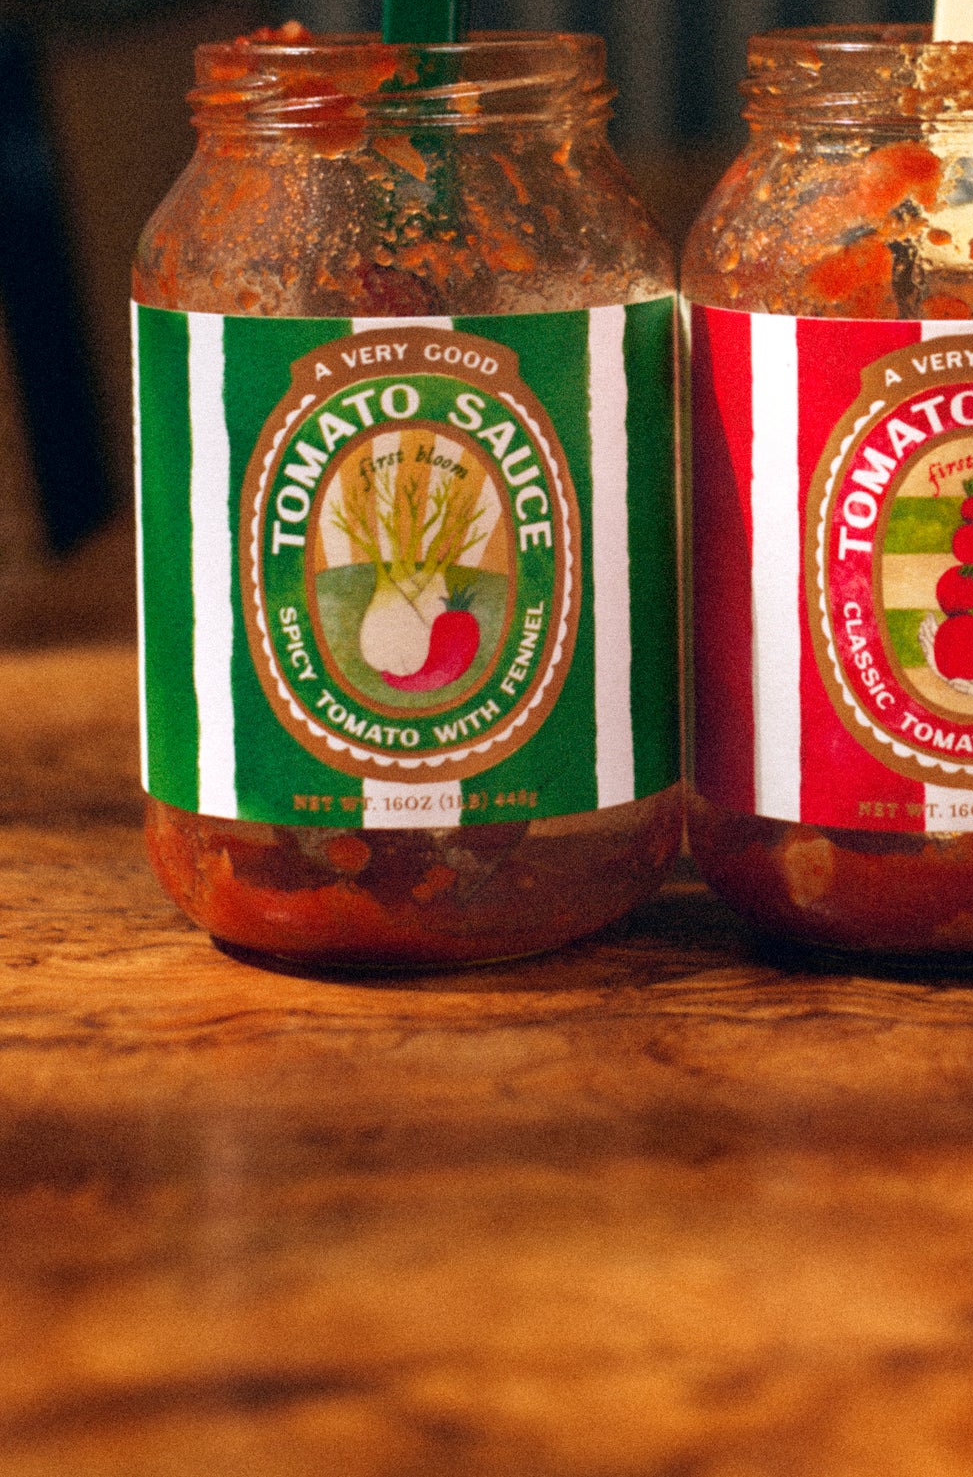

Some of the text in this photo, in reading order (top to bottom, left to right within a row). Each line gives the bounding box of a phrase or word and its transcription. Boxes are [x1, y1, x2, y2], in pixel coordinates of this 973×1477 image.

[314, 343, 499, 380] A VERY GOOD
[883, 368, 902, 387] A
[271, 383, 552, 555] TOMATO SAUCE
[359, 444, 469, 493] first bloom
[928, 455, 973, 498] first
[278, 600, 544, 747] SPICY TOMATO WITH FENNEL
[842, 601, 896, 710] CLASSIC
[293, 794, 333, 812] NET
[339, 796, 376, 812] WT.
[385, 796, 432, 811] 16OZ
[439, 791, 488, 811] (1LB)
[858, 801, 899, 818] NET
[905, 802, 943, 818] WT.
